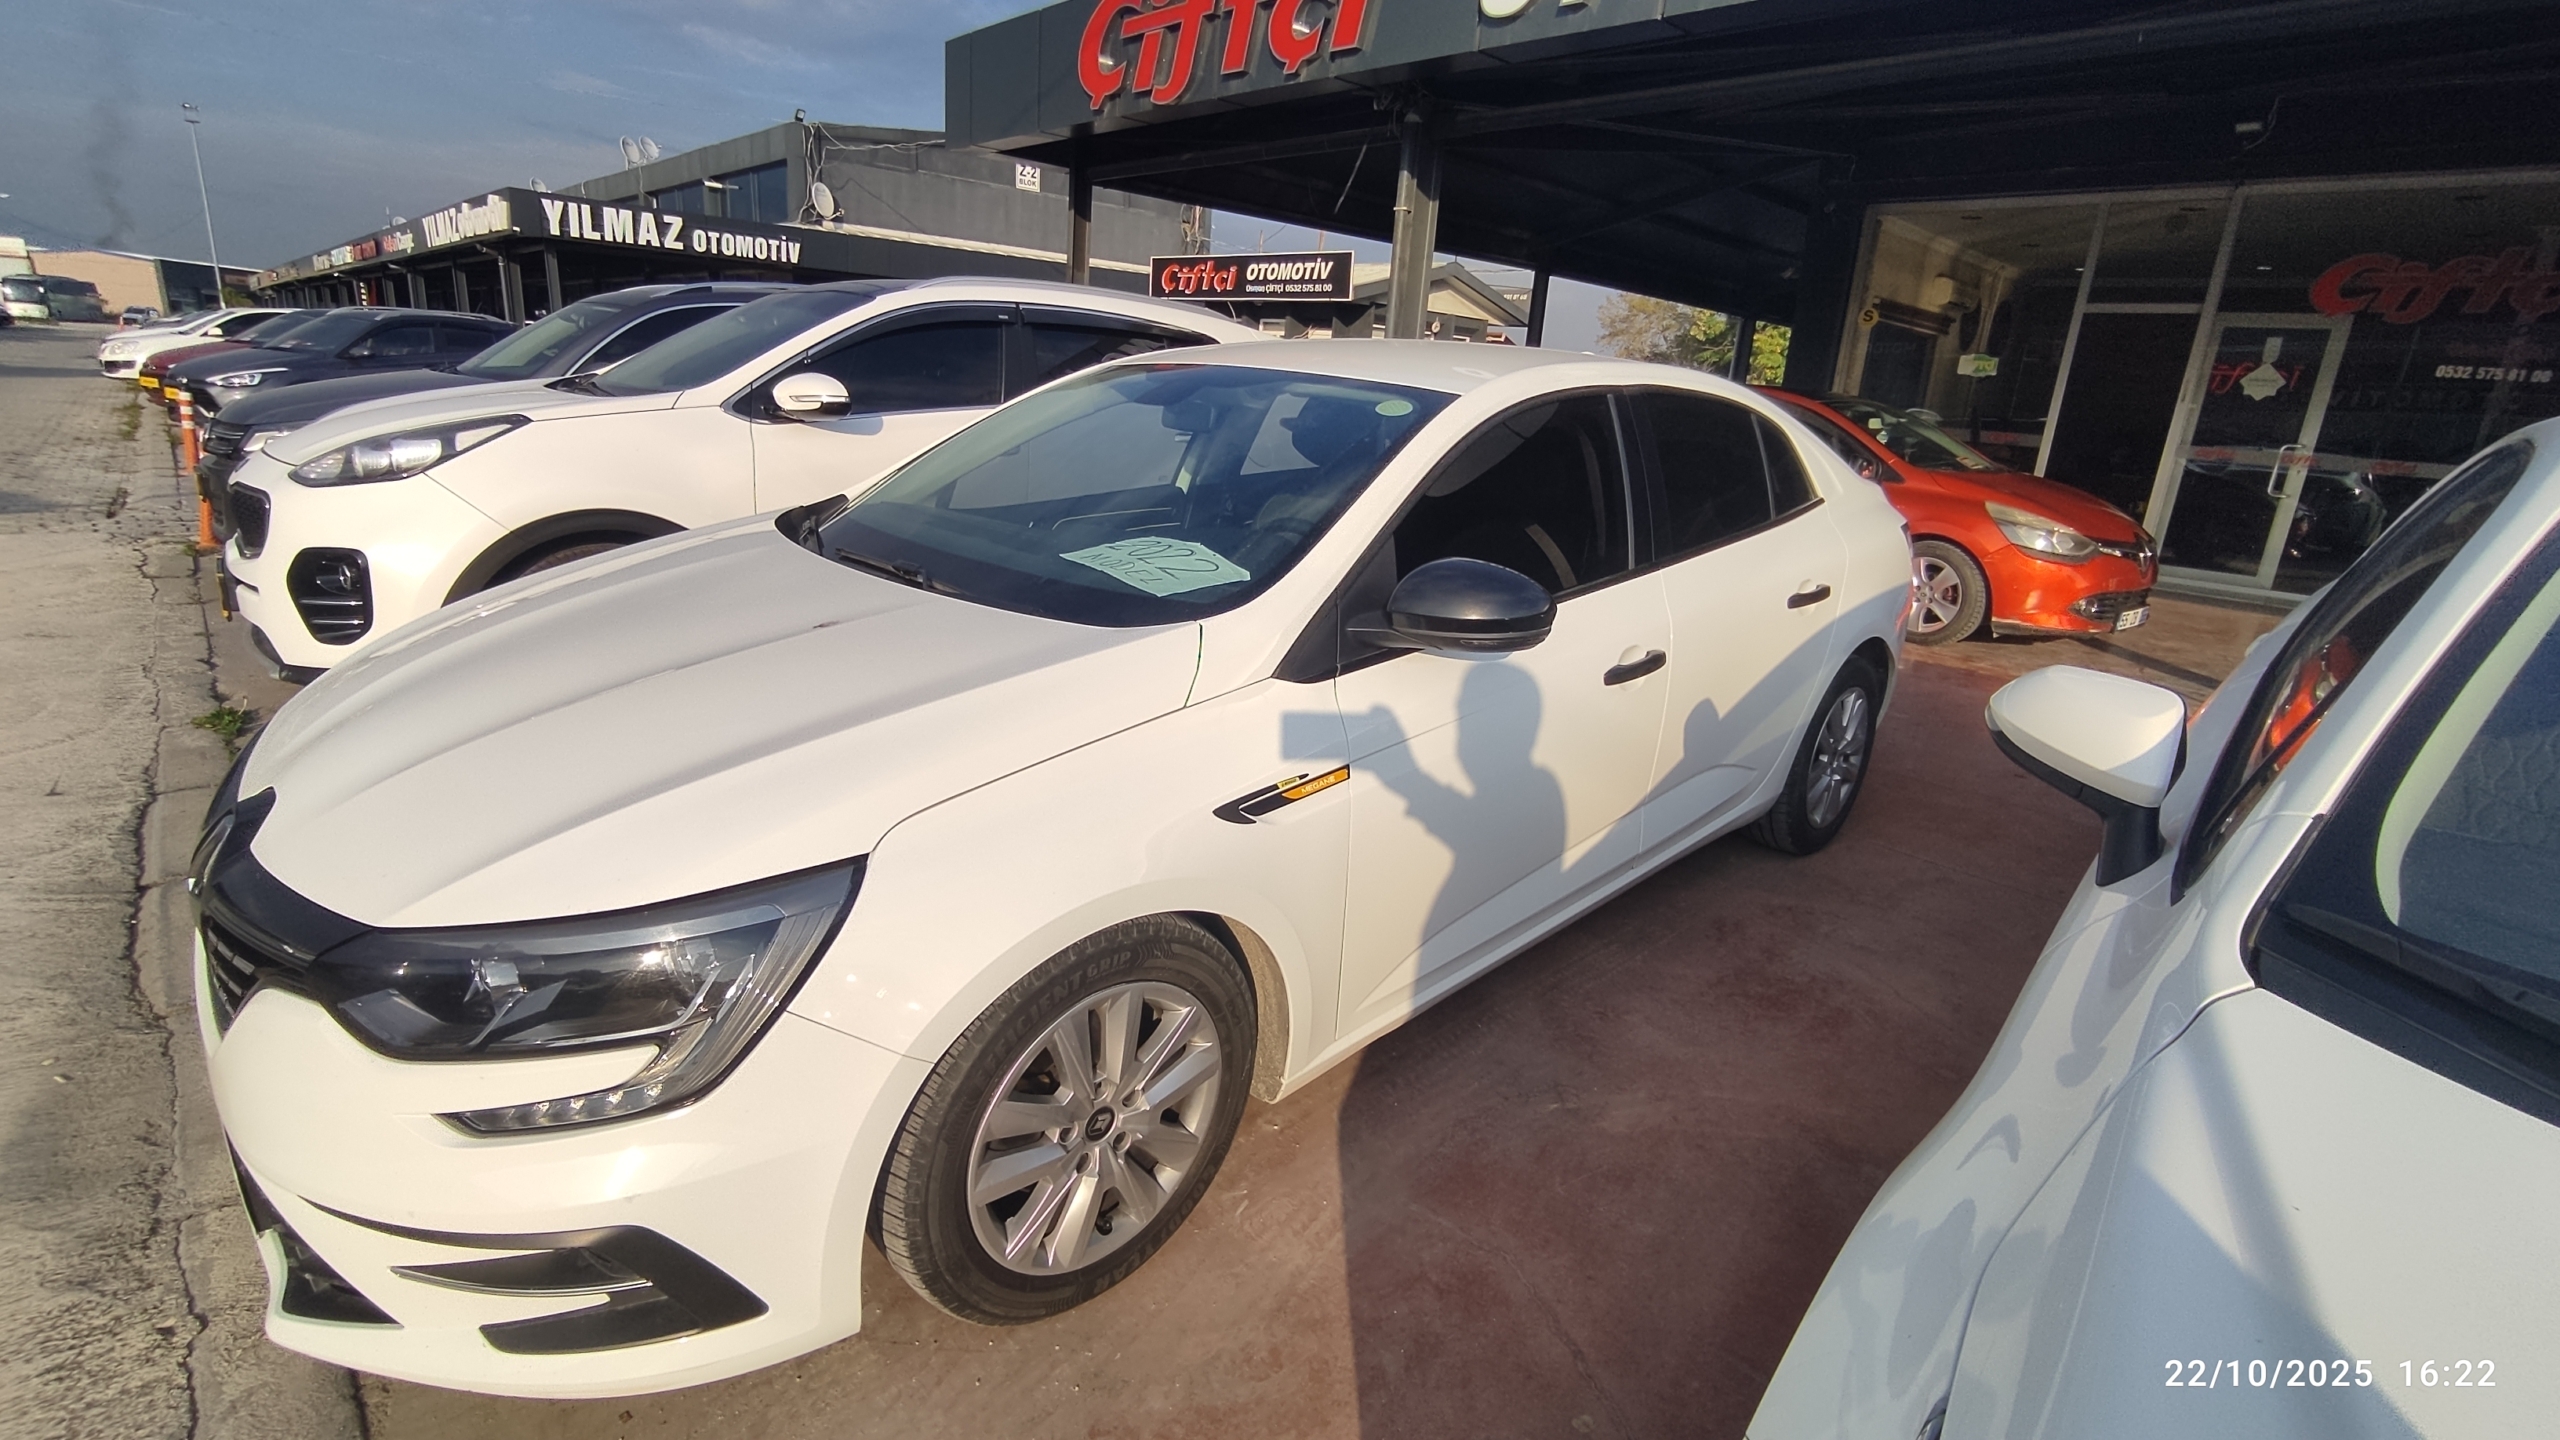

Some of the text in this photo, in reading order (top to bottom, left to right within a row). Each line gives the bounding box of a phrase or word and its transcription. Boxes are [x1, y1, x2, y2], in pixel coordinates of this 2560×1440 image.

[422, 207, 460, 248] YILMAZ
[540, 197, 801, 265] YILMAZ OTOMOTİV
[1161, 259, 1238, 294] Çiftçi
[1246, 257, 1334, 281] OTOMOTİV
[1285, 284, 1301, 292] 0532
[1302, 284, 1314, 292] 575
[1323, 283, 1333, 292] 00
[2309, 245, 2560, 325] Çiftç
[2435, 365, 2474, 379] 0532
[2475, 366, 2506, 380] 575
[1105, 539, 1220, 581] 2022
[1300, 775, 1336, 794] MEGANE
[1086, 950, 1131, 977] GRIP
